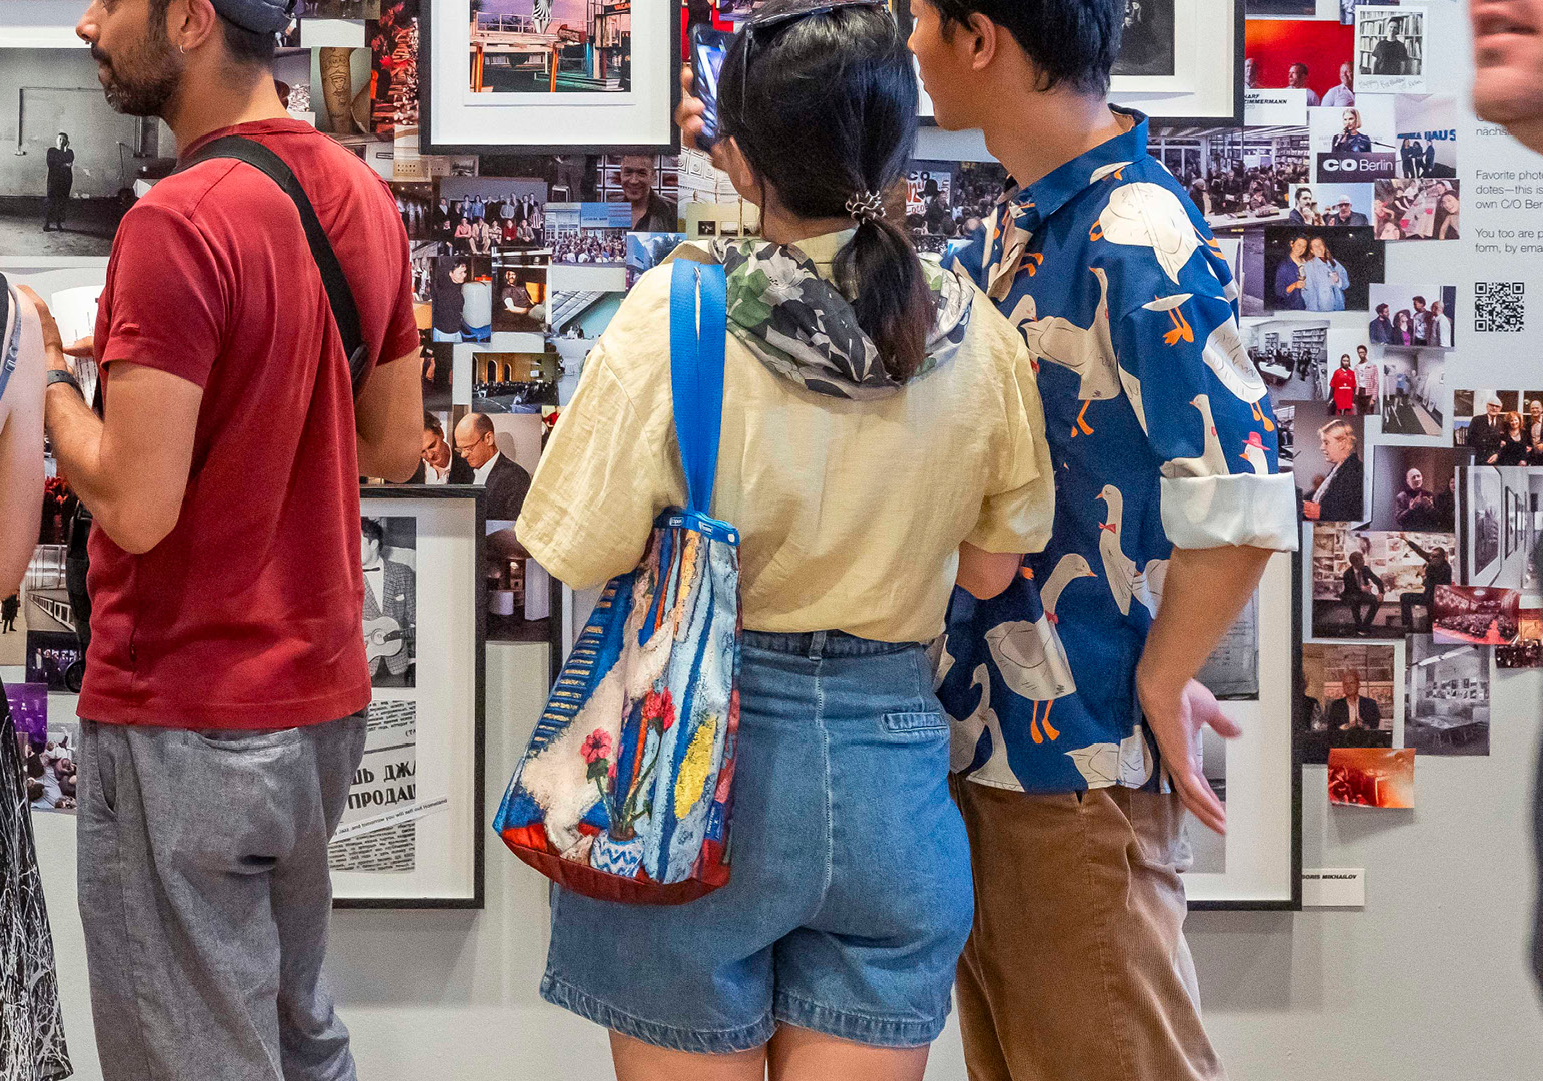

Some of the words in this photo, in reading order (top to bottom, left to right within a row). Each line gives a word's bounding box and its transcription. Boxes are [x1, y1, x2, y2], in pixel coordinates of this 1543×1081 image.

[1359, 159, 1393, 171] Berlin
[1475, 169, 1516, 180] Favorite
[1518, 170, 1543, 182] phot
[1475, 201, 1498, 209] own
[1500, 198, 1522, 209] C/O
[1475, 228, 1495, 238] You
[1498, 229, 1515, 238] too
[1518, 230, 1535, 238] are
[1475, 242, 1502, 254] form,
[1505, 243, 1518, 255] by
